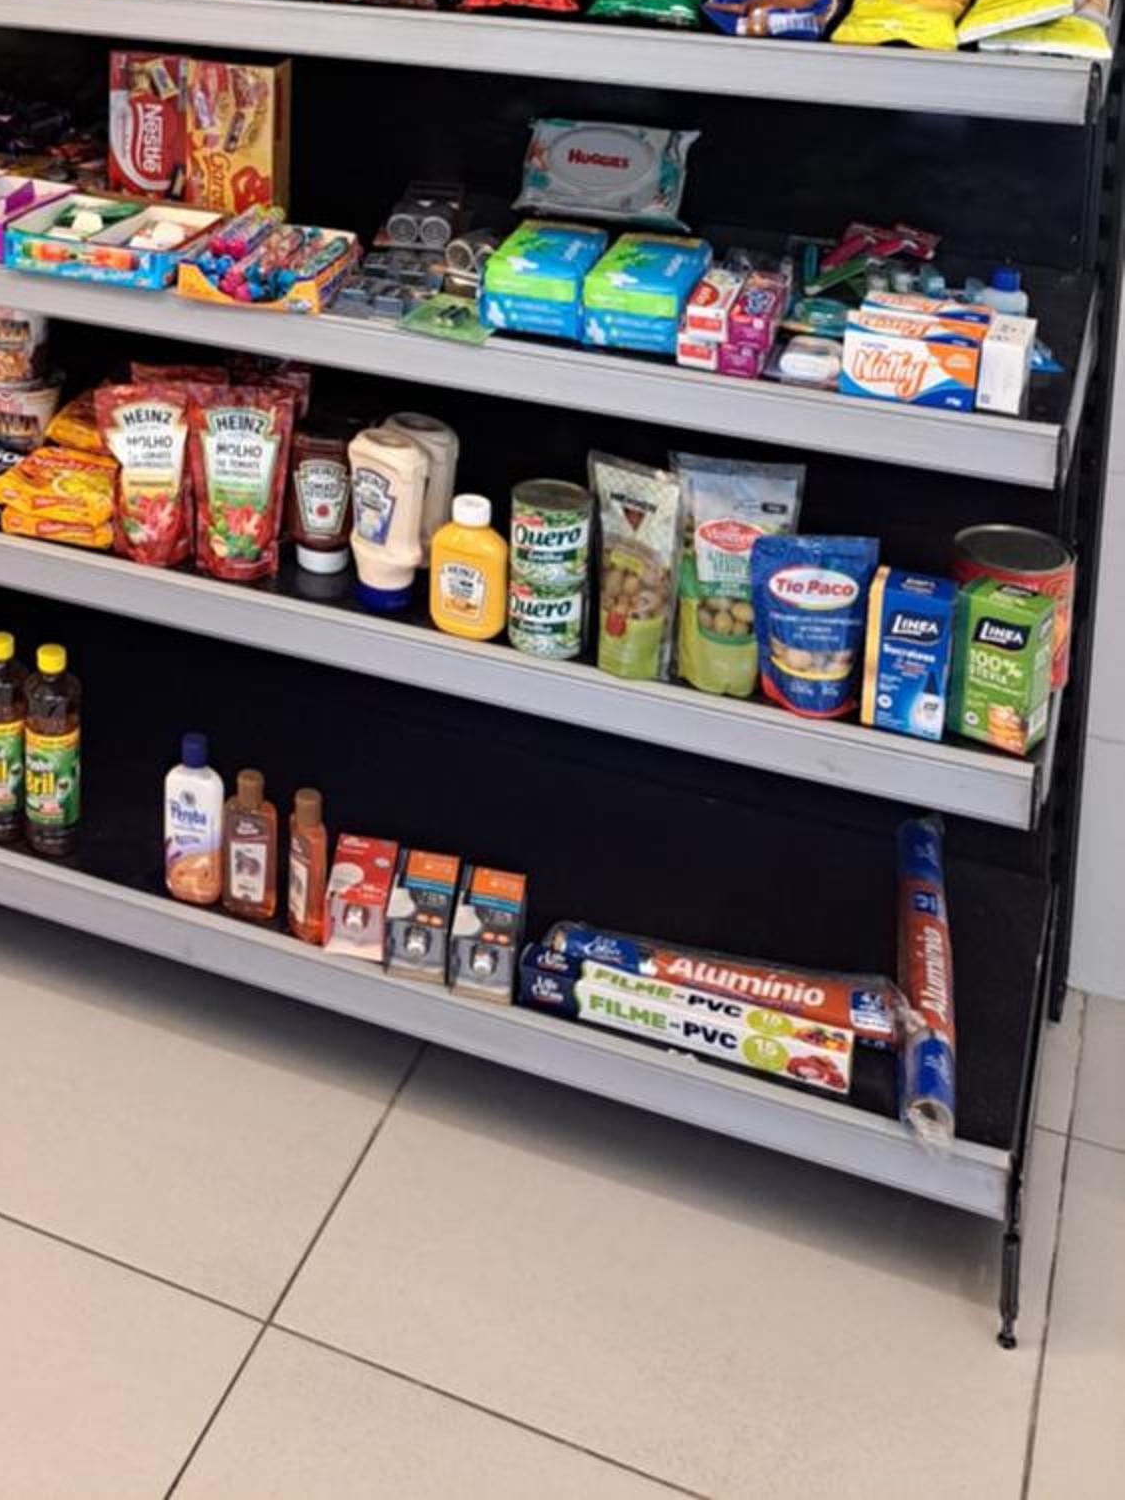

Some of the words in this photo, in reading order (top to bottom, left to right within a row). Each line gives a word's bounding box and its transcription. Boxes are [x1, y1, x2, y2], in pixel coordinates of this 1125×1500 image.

[123, 408, 173, 426] HEINZ
[216, 416, 265, 435] HEINZ
[216, 444, 263, 458] MOLHO
[515, 524, 582, 548] Quero
[775, 578, 804, 593] Tio
[807, 579, 855, 597] Paco
[667, 958, 826, 1008] Alumínio
